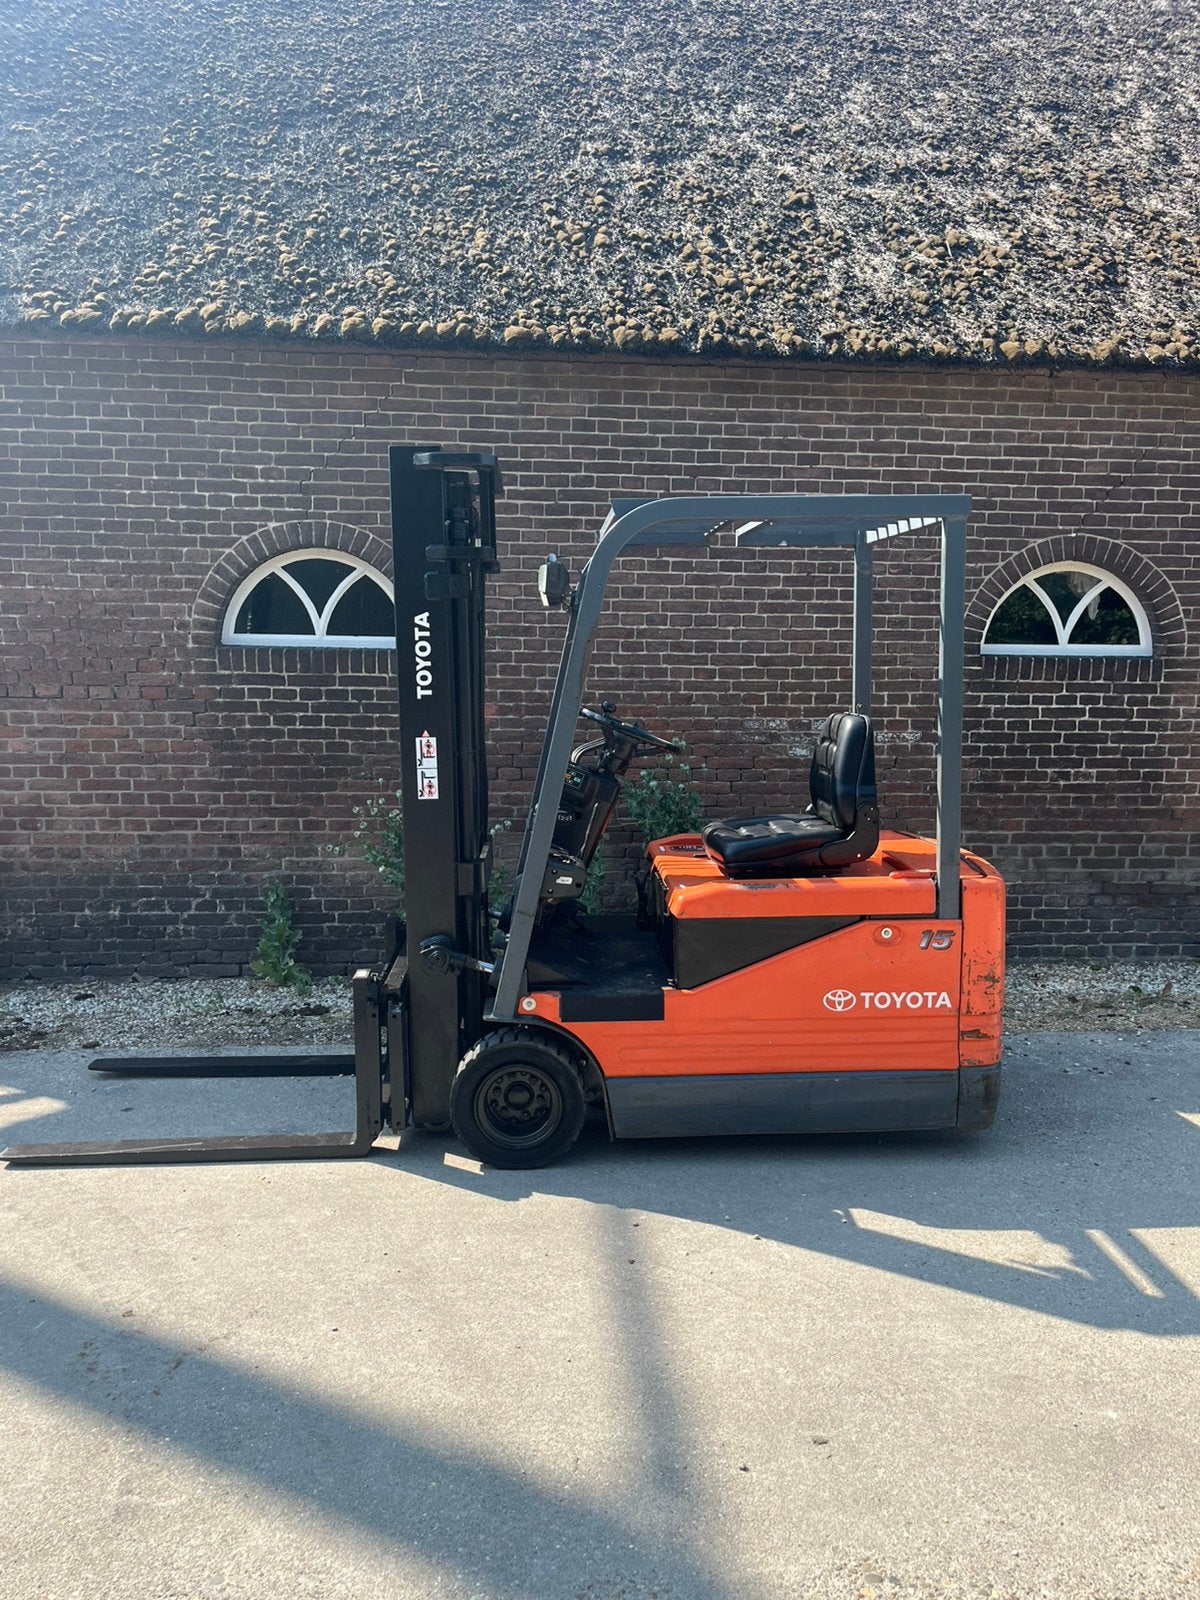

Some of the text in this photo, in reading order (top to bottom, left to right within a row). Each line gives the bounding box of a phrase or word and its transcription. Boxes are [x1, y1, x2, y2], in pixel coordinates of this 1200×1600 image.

[413, 611, 433, 700] TOYOTA
[919, 930, 955, 951] 15
[860, 991, 952, 1009] TOYOTA
